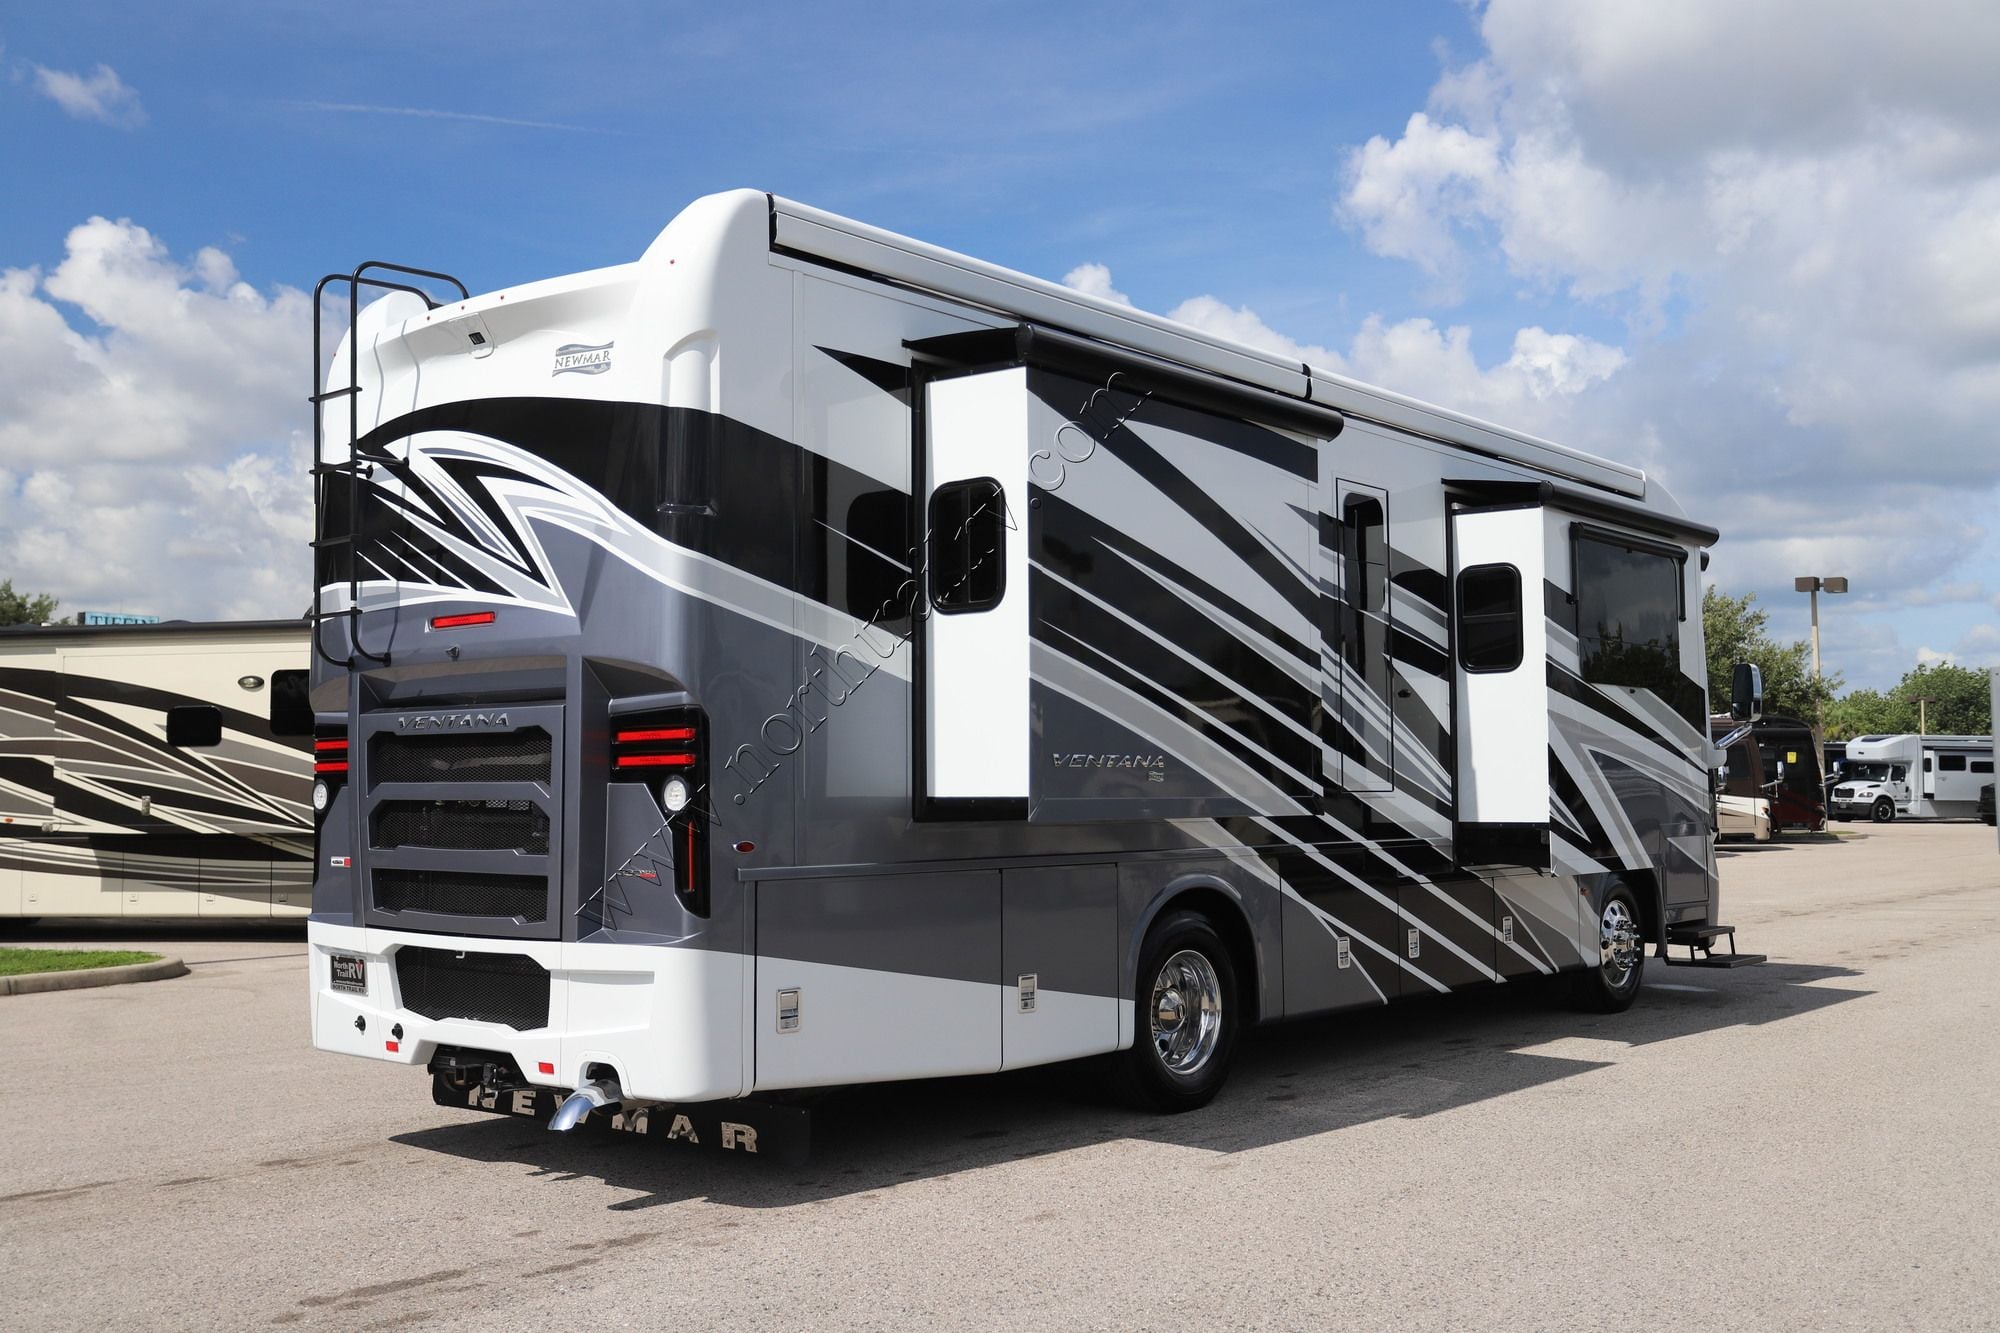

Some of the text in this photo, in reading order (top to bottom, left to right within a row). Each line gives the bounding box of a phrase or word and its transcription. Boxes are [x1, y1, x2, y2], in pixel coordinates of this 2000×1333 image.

[554, 350, 611, 368] NEWMAR
[398, 712, 509, 730] VENTANA
[1053, 753, 1164, 768] VENTANA
[349, 963, 363, 979] RV
[468, 1085, 758, 1152] NEMAR
